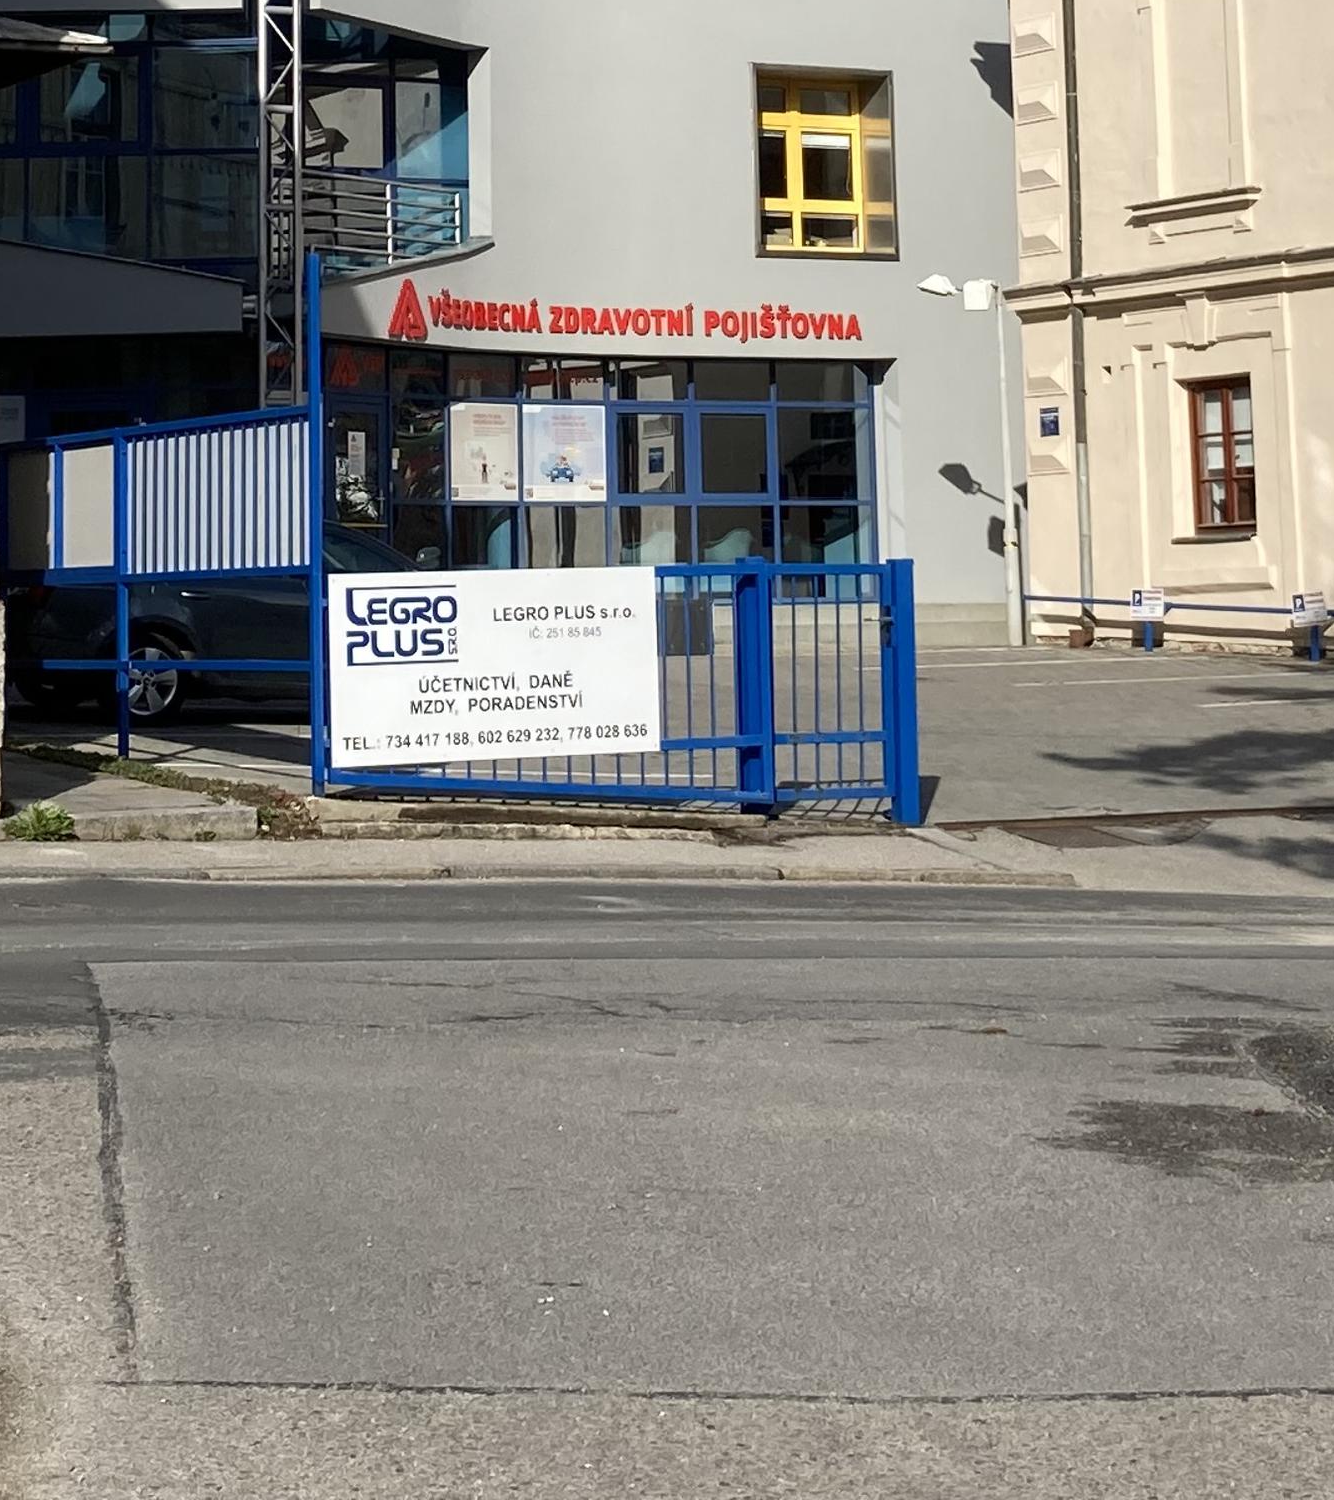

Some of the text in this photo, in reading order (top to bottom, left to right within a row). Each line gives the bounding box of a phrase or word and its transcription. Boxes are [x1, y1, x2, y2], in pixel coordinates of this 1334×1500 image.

[427, 287, 863, 343] VŠEOBECNÁ ZDRAVOTNÍ POJIŠŤOVNA
[346, 587, 457, 626] LEGRO
[493, 605, 636, 621] LEGRO PLUS s.r.o.
[529, 626, 602, 639] IČ: 251 85 845
[347, 628, 444, 666] PLUS
[419, 670, 573, 693] ÚČETNICTVÍ, DANĚ
[410, 691, 584, 716] MZDY, PORADENSTVÍ
[343, 723, 648, 750] TEL.: 734 417 188, 602 629 232, 778 028 636
